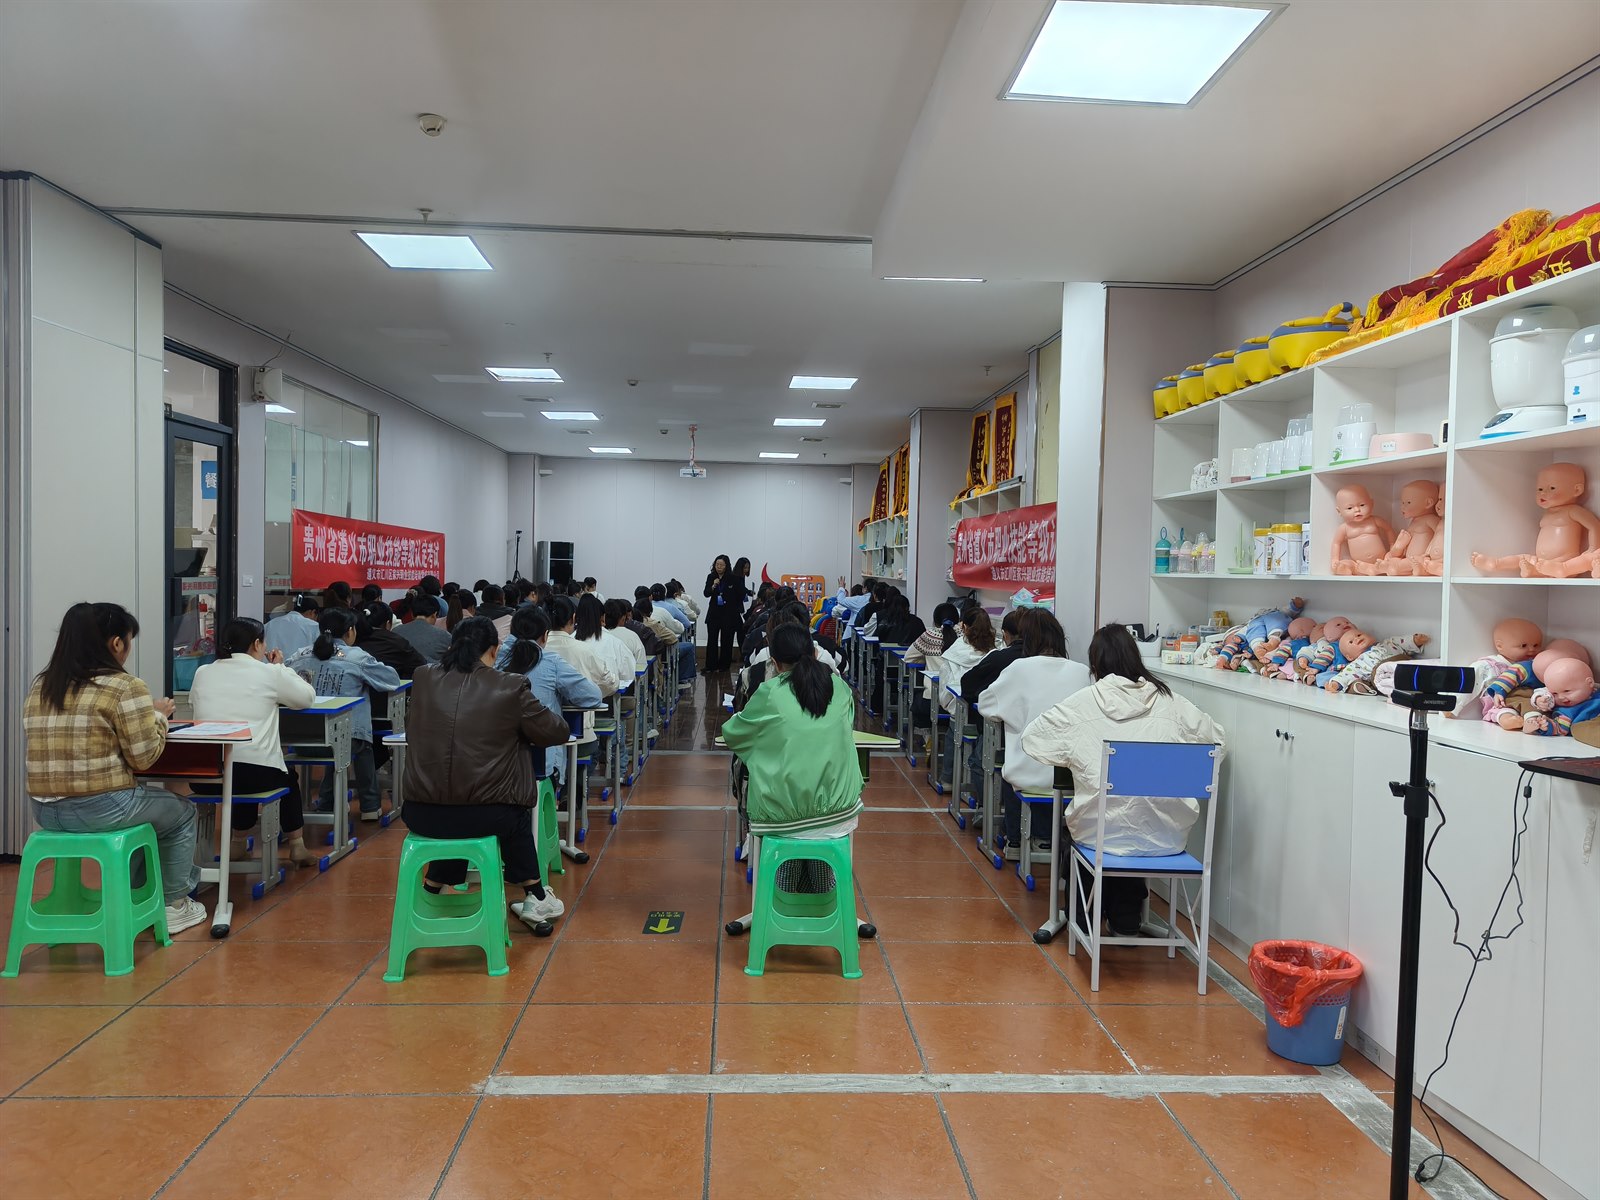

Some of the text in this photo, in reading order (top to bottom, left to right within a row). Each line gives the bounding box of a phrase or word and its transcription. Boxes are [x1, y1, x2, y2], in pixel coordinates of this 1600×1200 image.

[303, 523, 440, 569] 贵州省遵义市职业技能等级认定考试
